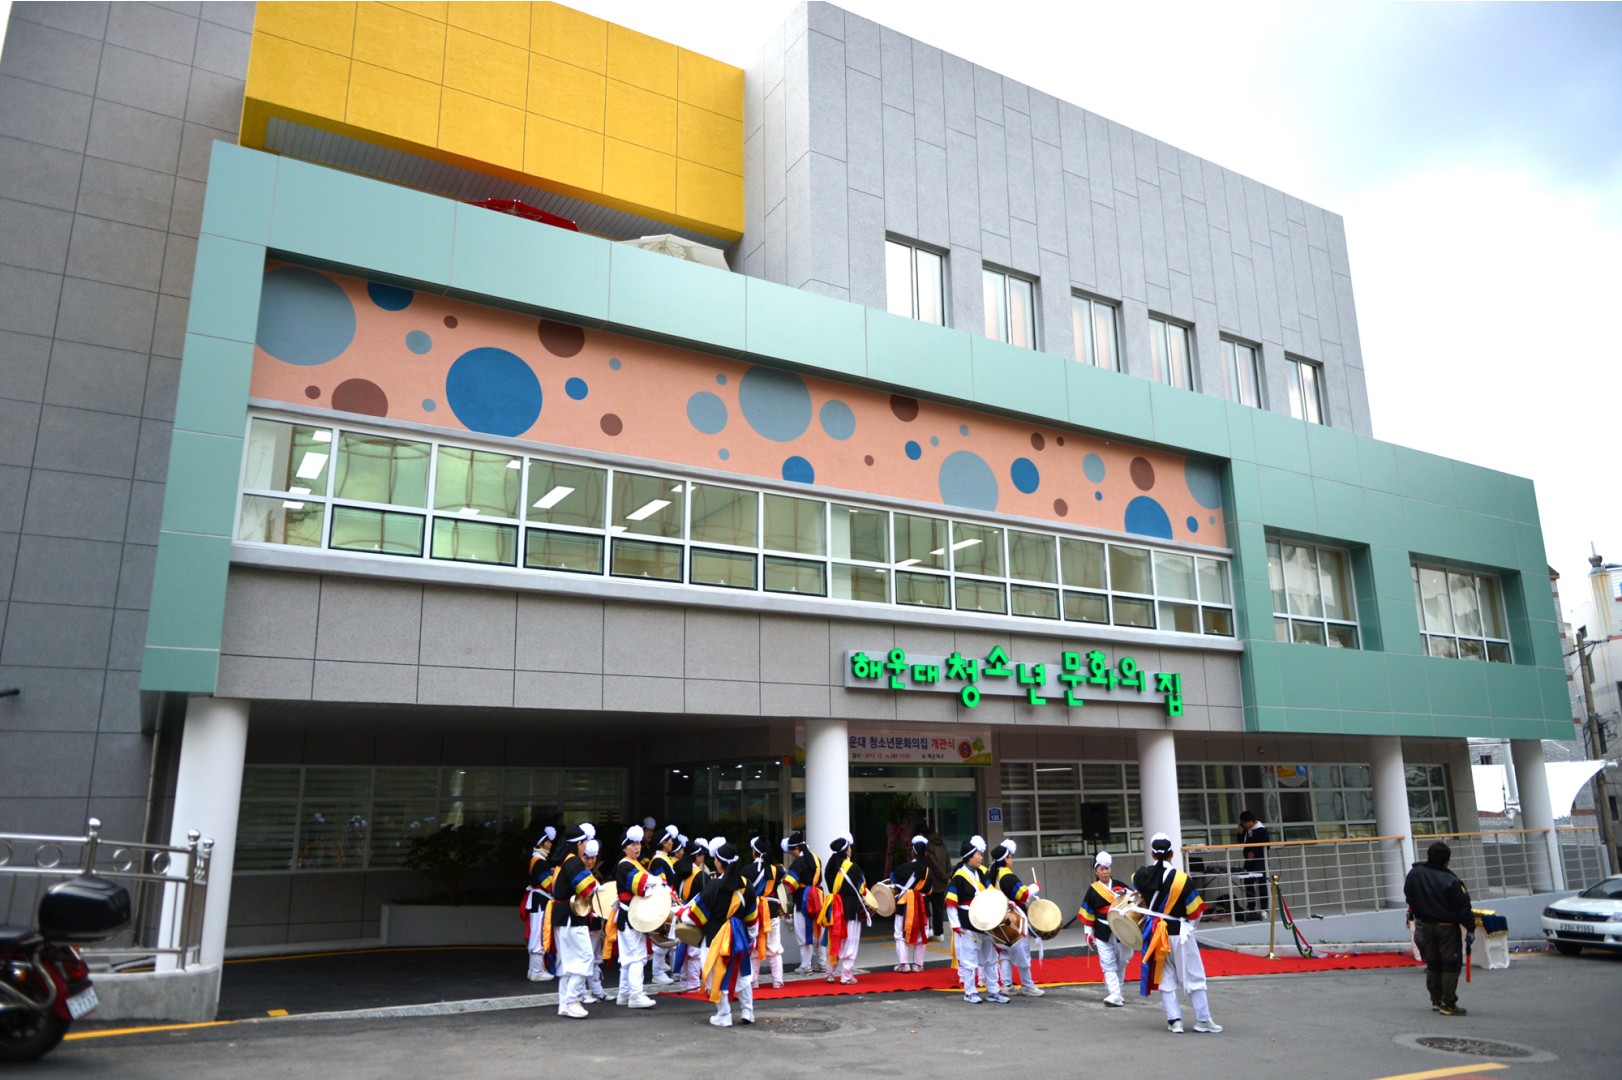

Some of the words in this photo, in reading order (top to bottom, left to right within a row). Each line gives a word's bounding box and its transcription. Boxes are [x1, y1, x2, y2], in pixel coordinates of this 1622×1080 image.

[851, 648, 939, 689] 해운대
[946, 645, 1046, 708] 청소년
[1058, 650, 1146, 707] 문화의
[1154, 673, 1183, 717] 집
[848, 735, 866, 749] 운대
[869, 735, 928, 750] 청소년문화의집
[931, 738, 955, 750] 개관식
